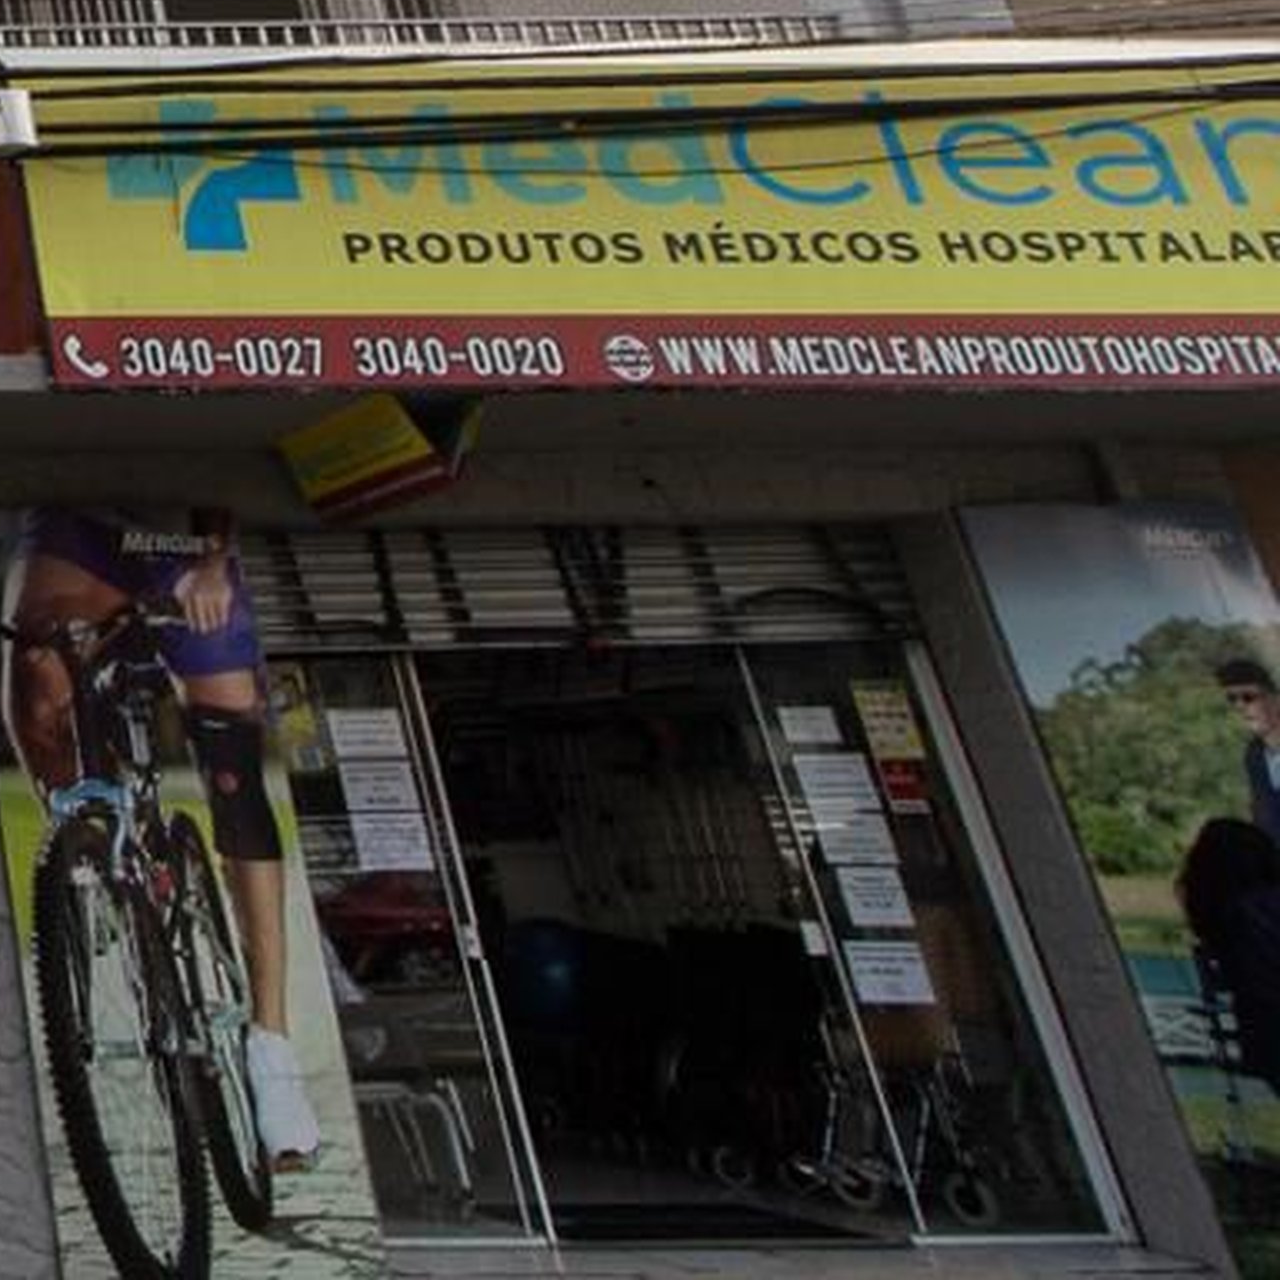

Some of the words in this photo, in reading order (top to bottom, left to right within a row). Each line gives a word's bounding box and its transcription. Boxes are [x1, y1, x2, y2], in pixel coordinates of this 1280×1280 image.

[312, 90, 1280, 206] MedClean
[343, 230, 644, 265] PRODUTOS
[665, 222, 921, 265] MÉDICOS
[120, 336, 324, 378] 3040-0027
[353, 336, 565, 378] 3040-0020
[657, 334, 1280, 376] WWW.MEDCLEANPRODUTOHOSPITA
